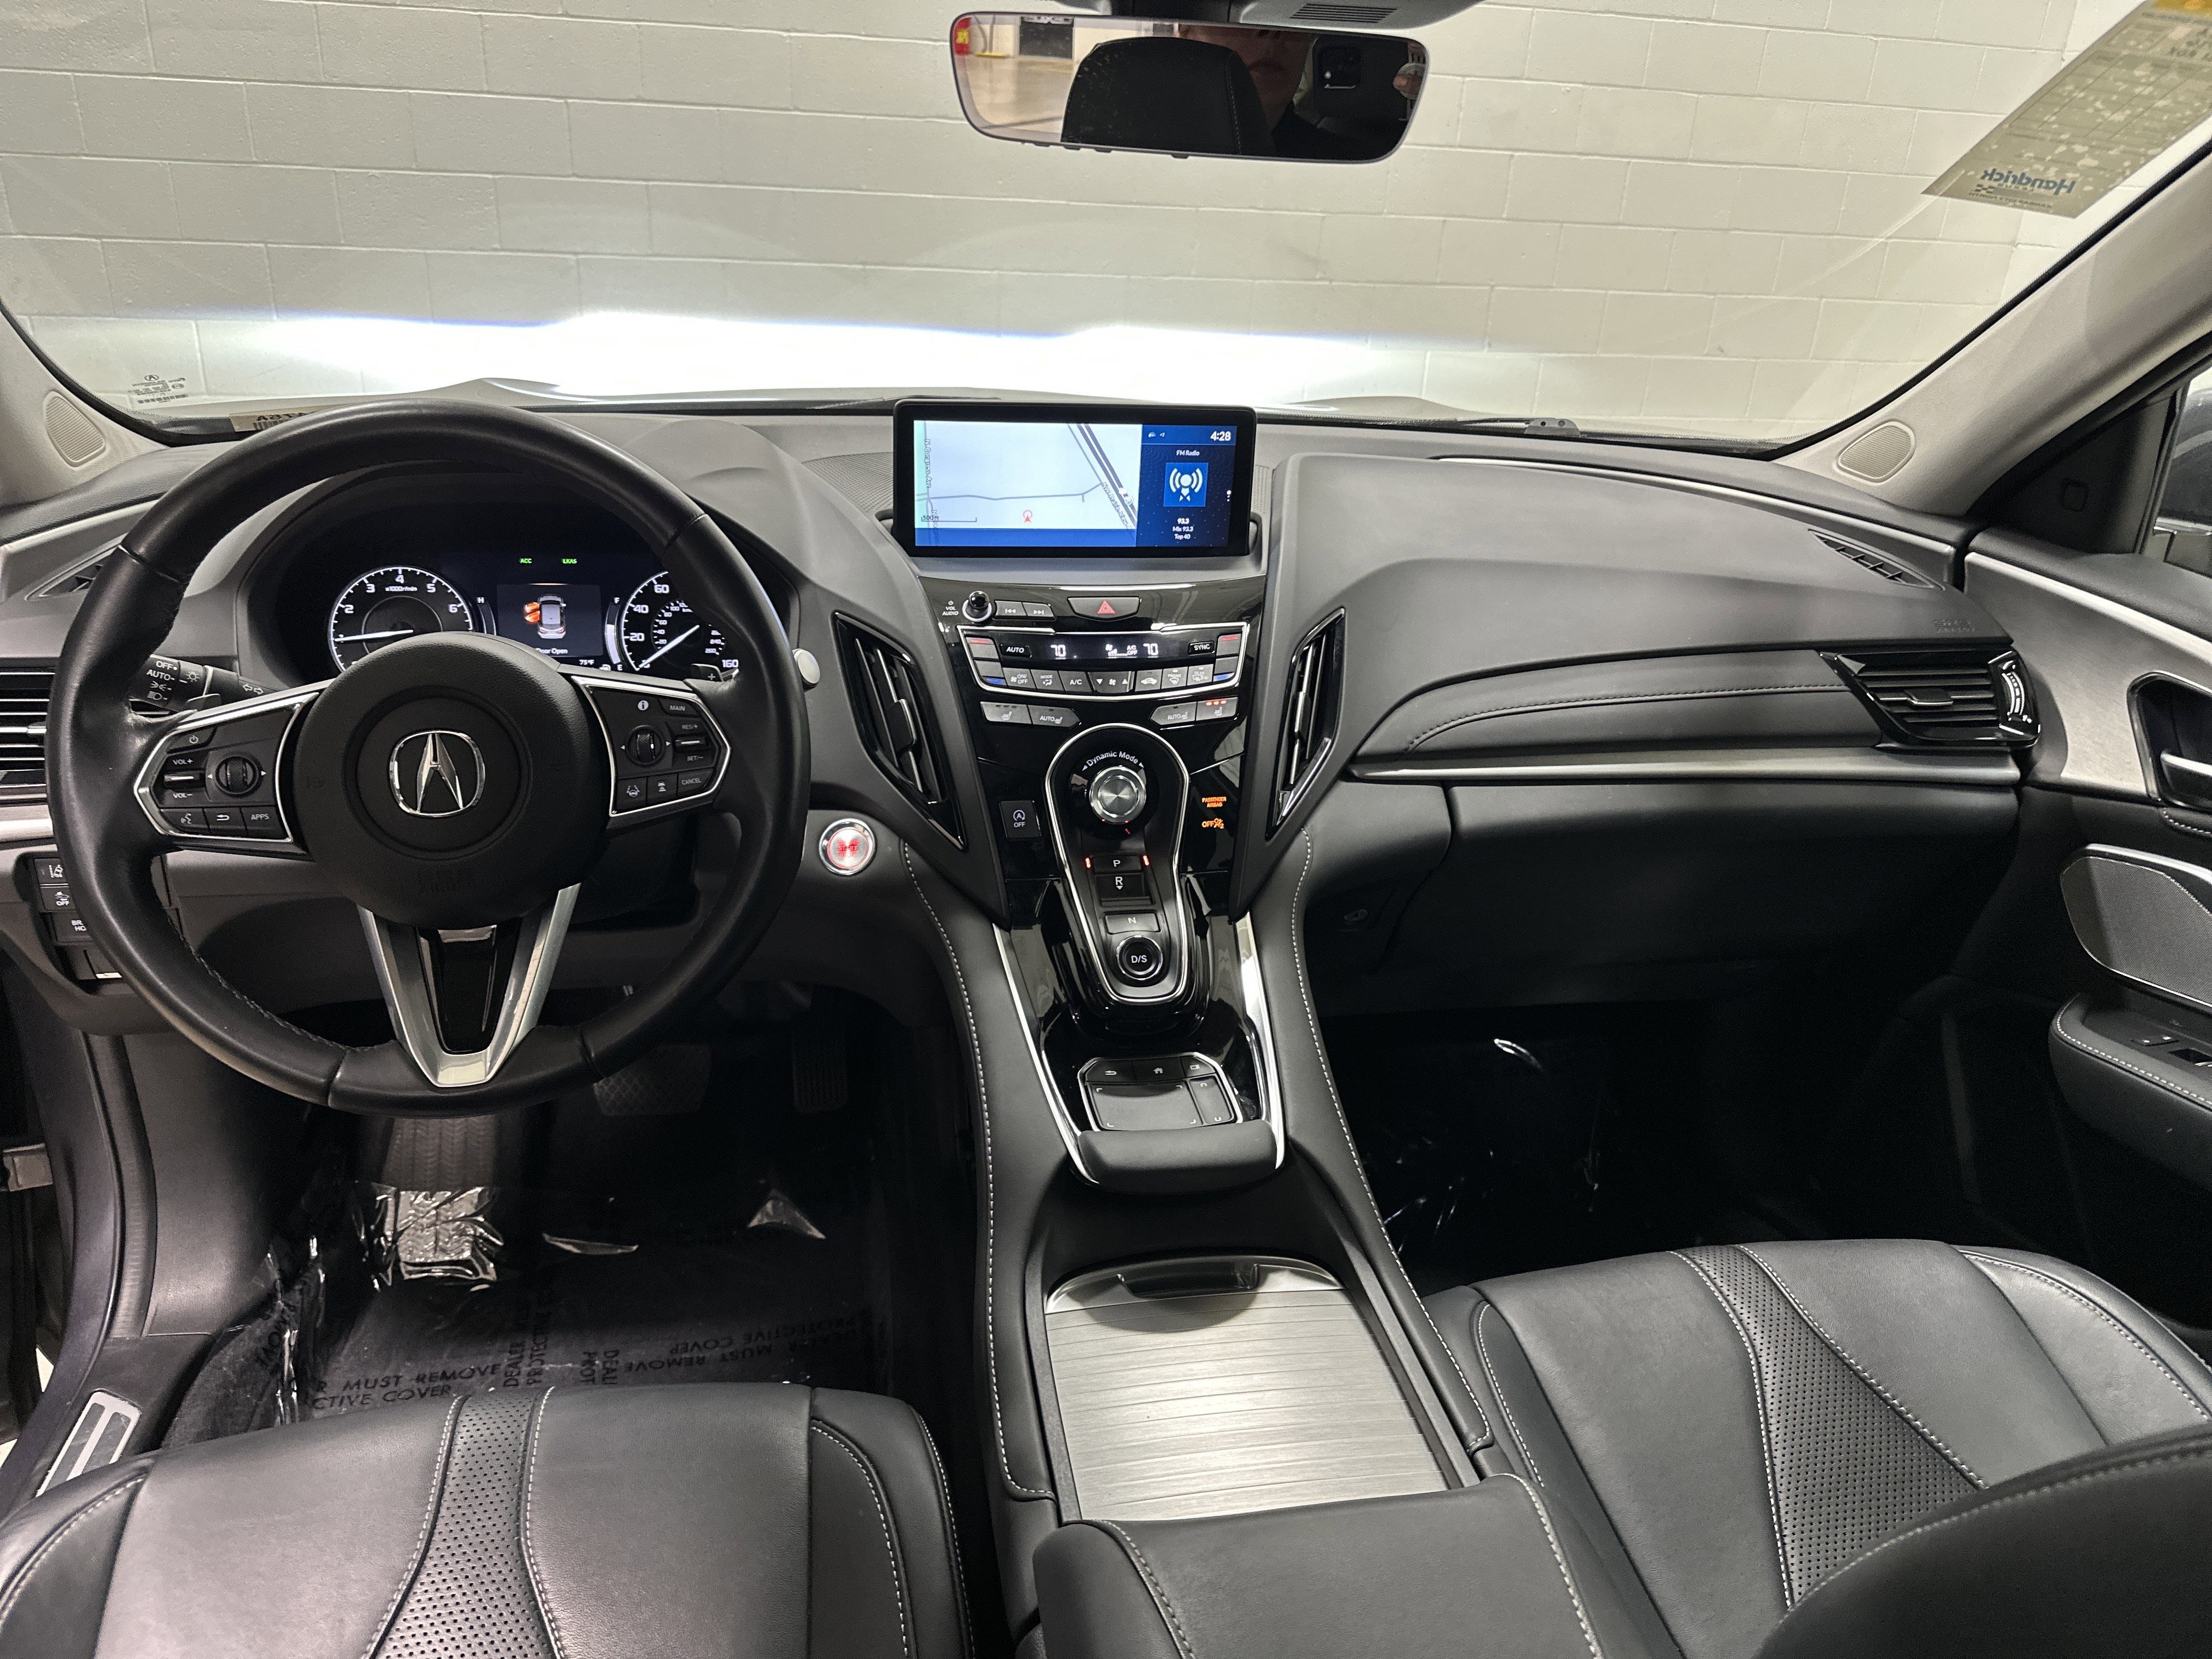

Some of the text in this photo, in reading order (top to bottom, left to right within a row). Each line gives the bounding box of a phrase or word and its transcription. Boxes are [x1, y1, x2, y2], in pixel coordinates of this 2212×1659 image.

[1210, 431, 1232, 441] 4:28
[395, 575, 404, 583] 4
[366, 584, 375, 593] 3
[427, 584, 436, 592] 5
[654, 584, 669, 593] 60
[345, 605, 354, 613] 2
[449, 604, 458, 613] 6
[633, 605, 649, 613] 40
[630, 633, 645, 641] 20
[1051, 644, 1066, 657] 70
[1143, 643, 1159, 656] 70
[155, 661, 173, 670] OFF
[722, 659, 739, 668] 160
[146, 669, 171, 681] AUTO
[1086, 751, 1139, 766] Dynamic Mode
[681, 777, 702, 785] CANCEL
[251, 813, 270, 821] APPS
[1115, 877, 1123, 885] R
[1131, 955, 1147, 963] D/S
[669, 1337, 734, 1355] COVER
[719, 1345, 773, 1363] MUST
[624, 1355, 706, 1373] REMOVE
[343, 1374, 402, 1391] MUST
[416, 1363, 501, 1384] REMOVE
[383, 1384, 452, 1402] COVER
